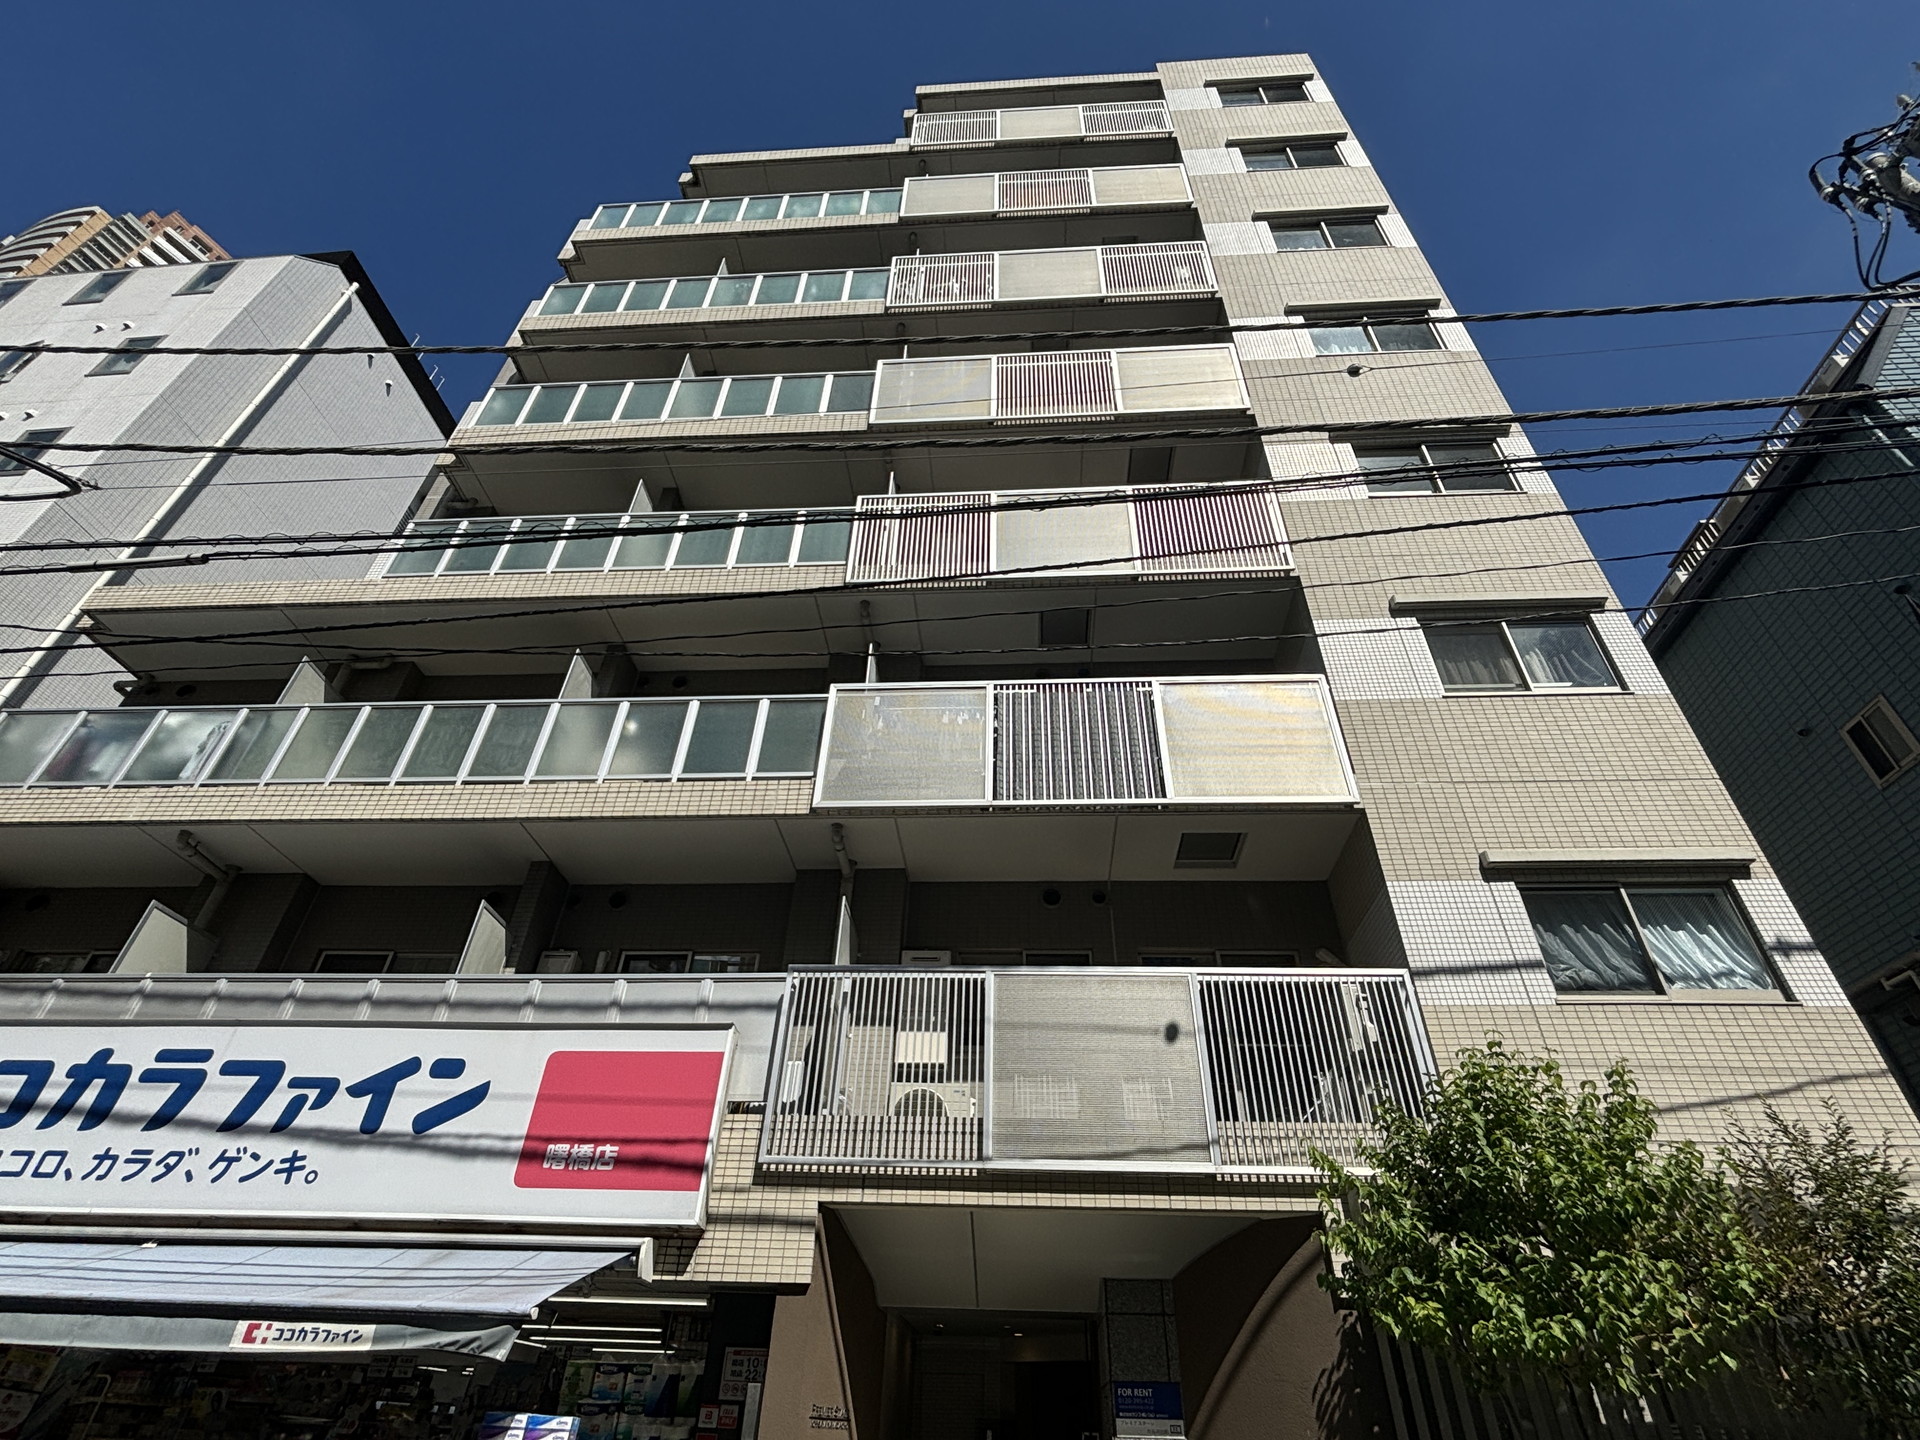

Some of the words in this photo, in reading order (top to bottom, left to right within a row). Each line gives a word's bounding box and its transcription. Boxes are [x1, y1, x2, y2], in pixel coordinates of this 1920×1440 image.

[0, 1146, 319, 1184] コロ、カラダ、ゲンキ。
[543, 1143, 619, 1170] 曙橋店
[272, 1327, 363, 1343] ココカラファイン
[1117, 1388, 1133, 1396] FOR
[1133, 1388, 1153, 1397] RENT
